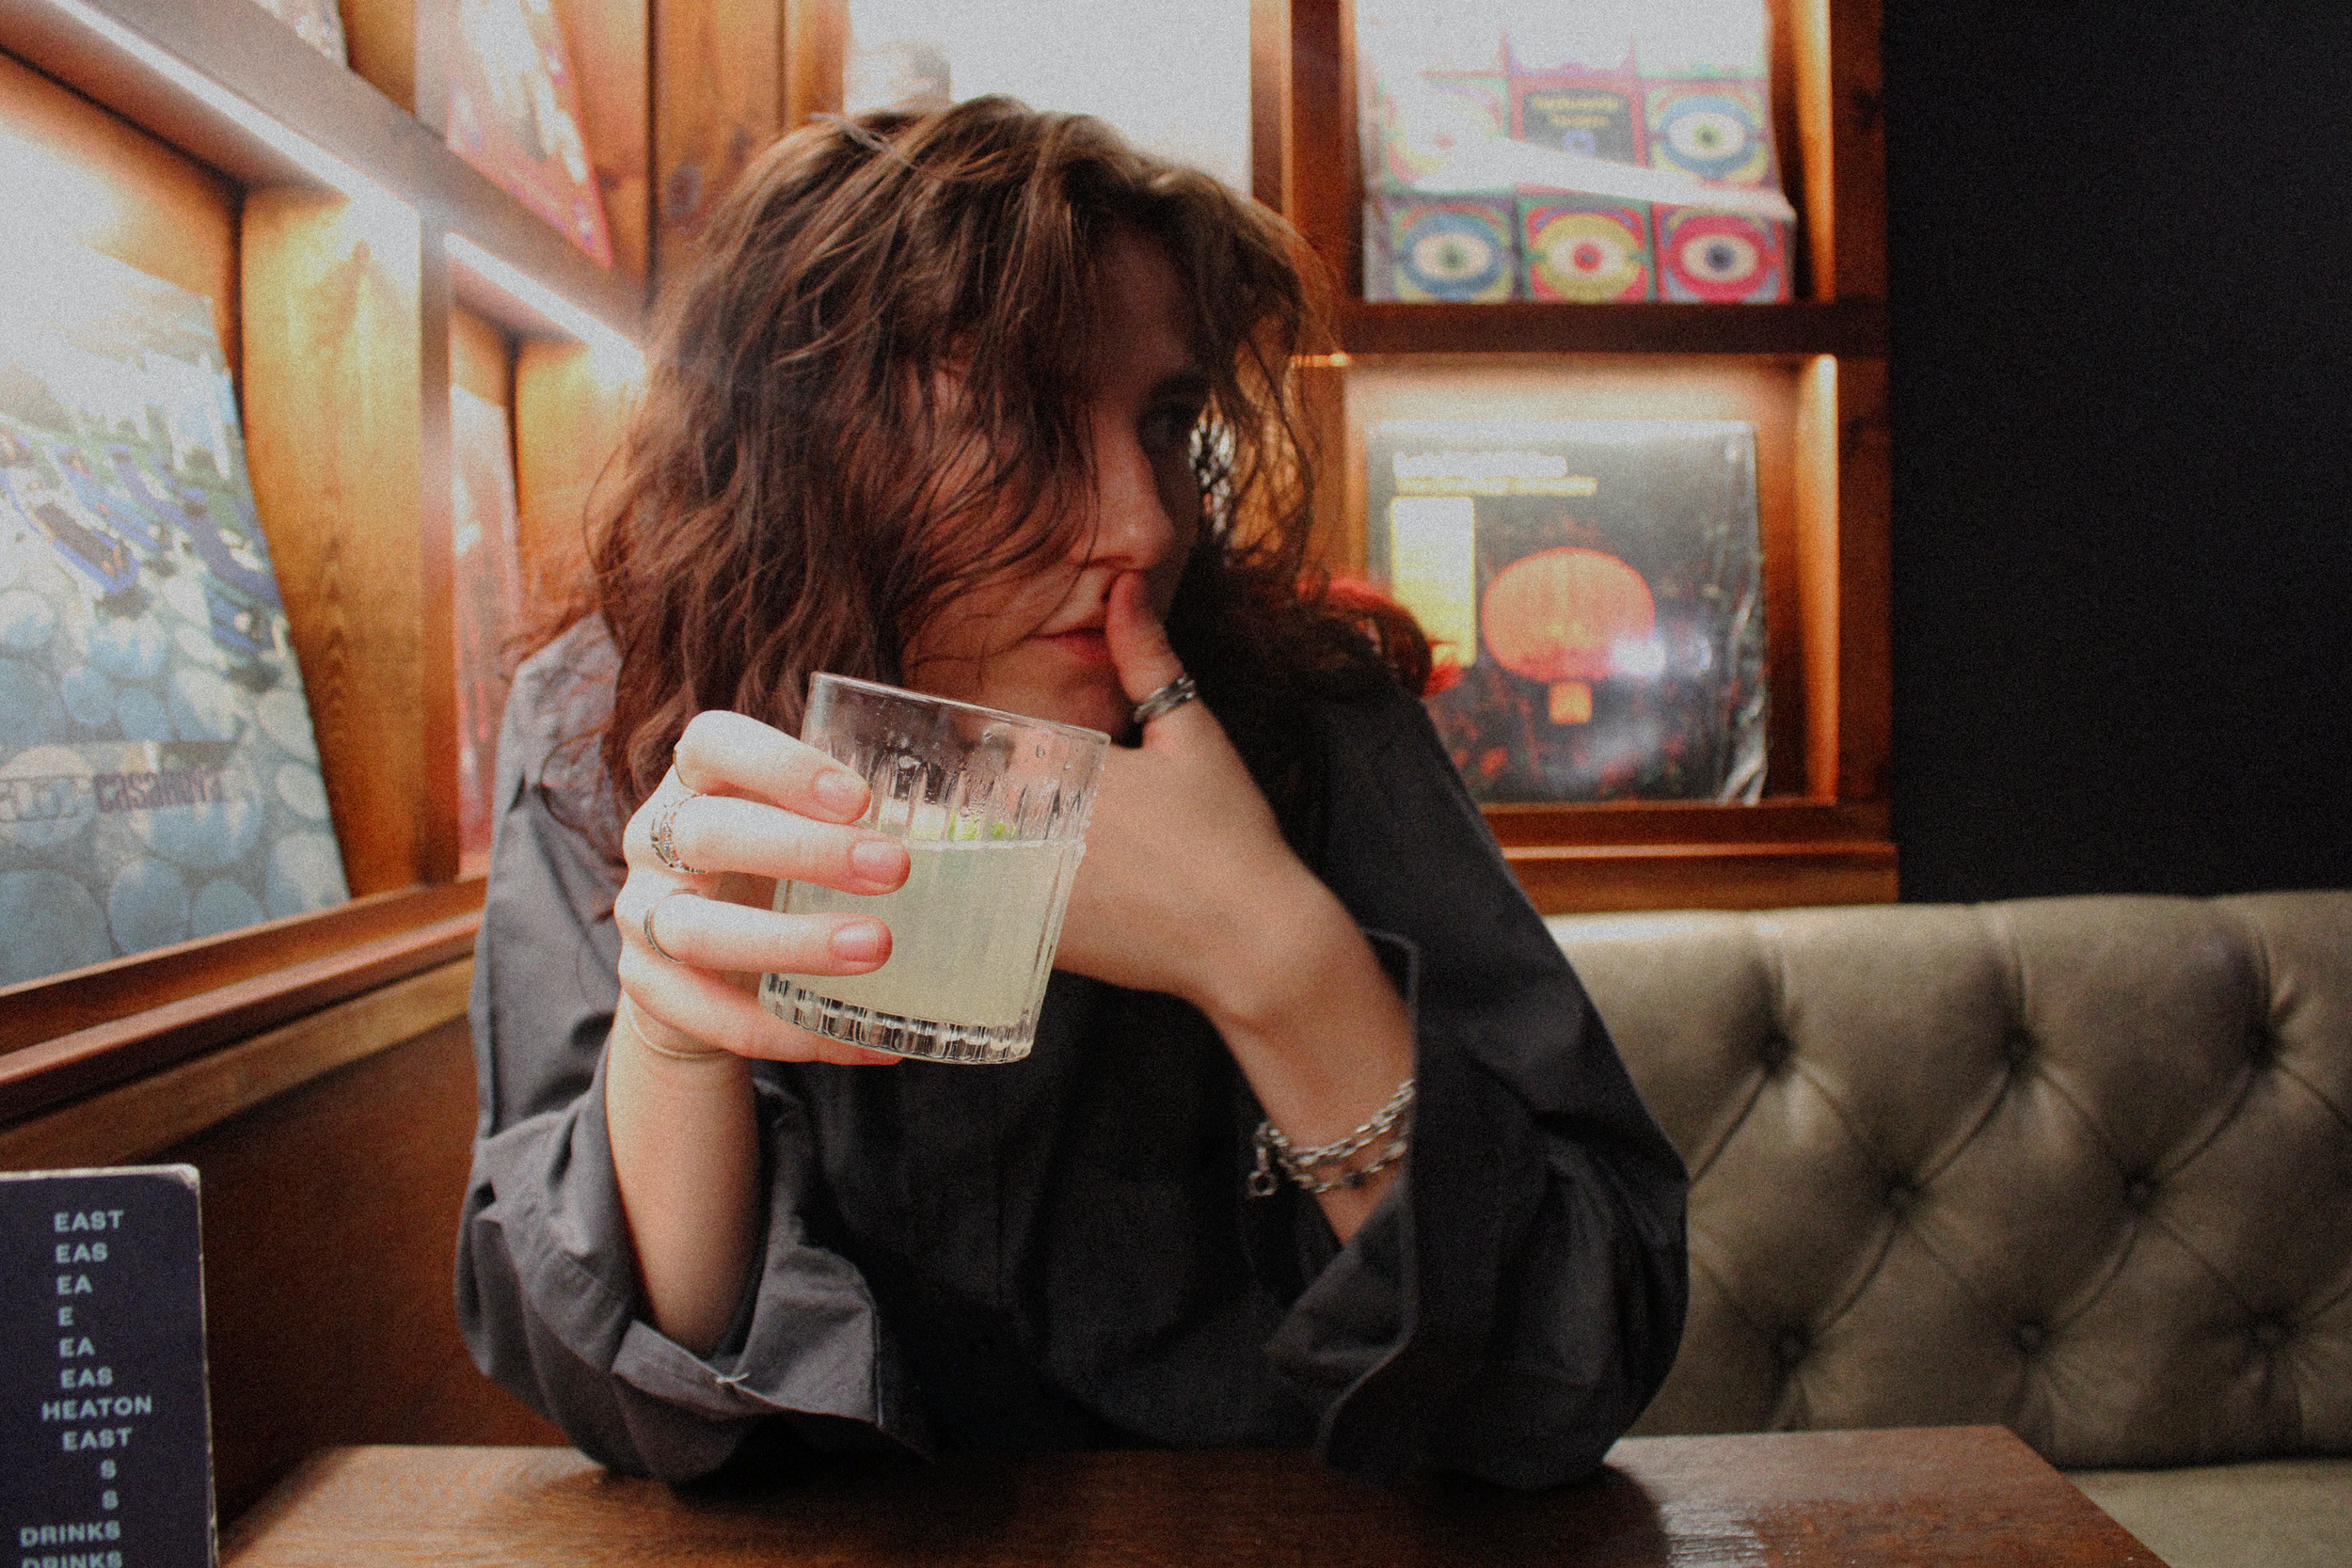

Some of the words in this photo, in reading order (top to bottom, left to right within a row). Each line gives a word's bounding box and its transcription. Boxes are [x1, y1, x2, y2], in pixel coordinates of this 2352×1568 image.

[54, 1210, 123, 1232] EAST
[56, 1243, 108, 1263] EAS
[57, 1275, 92, 1295] EA
[58, 1307, 72, 1326] E
[59, 1337, 94, 1357] EA
[60, 1368, 113, 1388] EAS
[41, 1397, 151, 1420] HEATON
[62, 1428, 132, 1450] EAST
[20, 1520, 120, 1546] DRINKS
[22, 1550, 122, 1568] DRINKS
